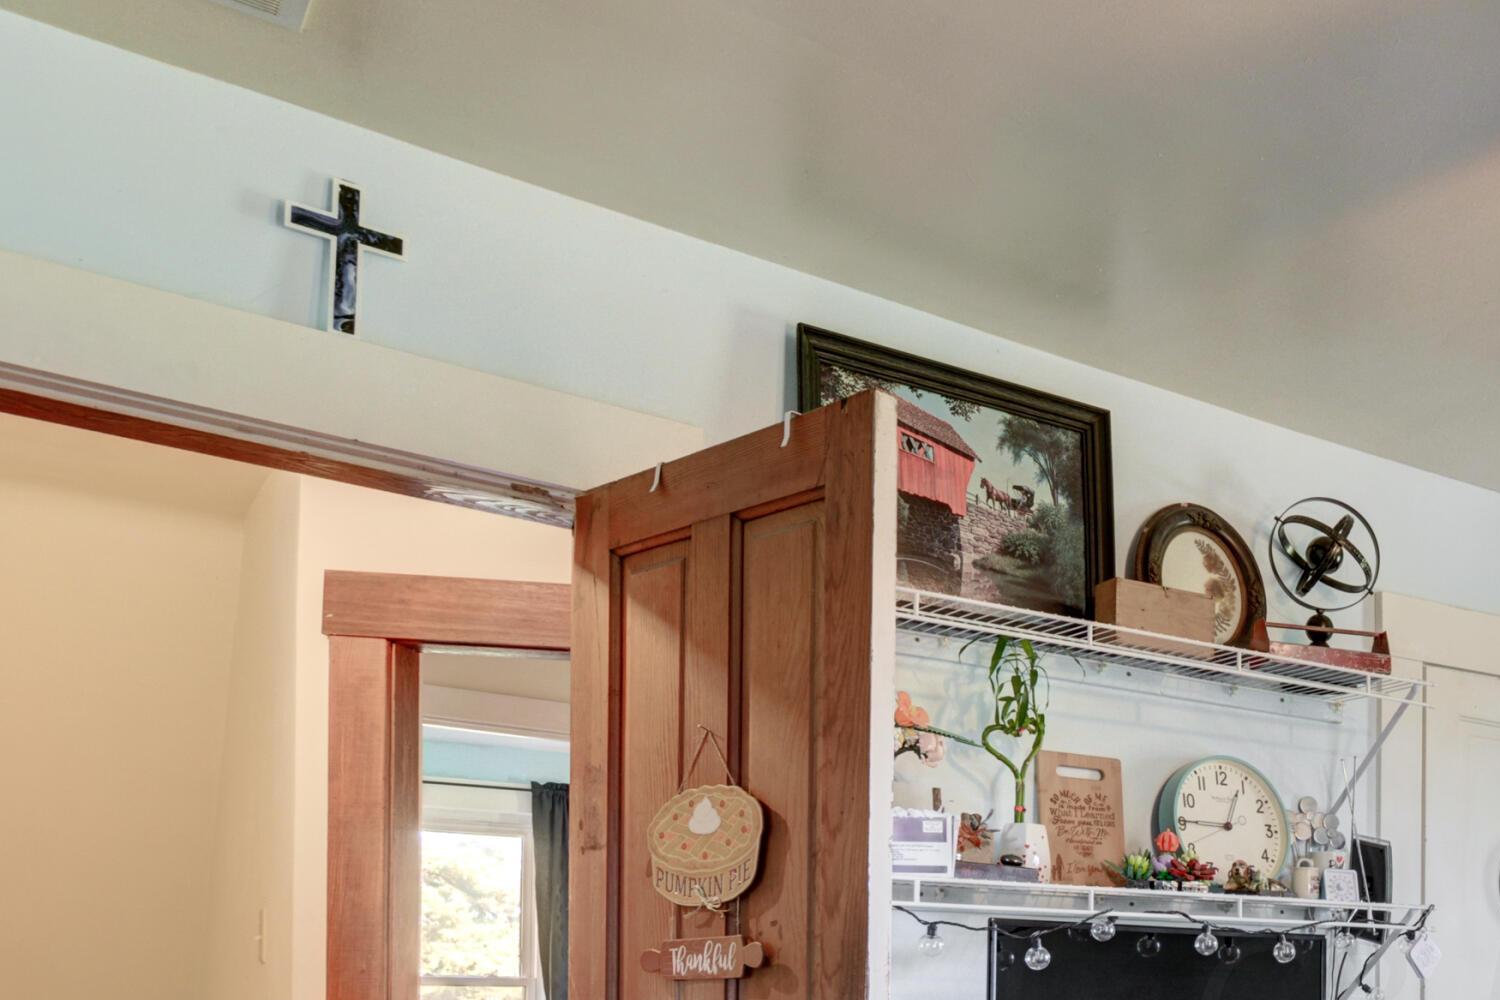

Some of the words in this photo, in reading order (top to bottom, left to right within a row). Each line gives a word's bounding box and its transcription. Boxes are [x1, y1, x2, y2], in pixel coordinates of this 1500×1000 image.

[1197, 775, 1206, 791] 11
[1215, 771, 1228, 786] 12
[1241, 780, 1245, 795] 1
[1182, 793, 1195, 808] 10
[1256, 799, 1265, 814] 2
[1178, 816, 1187, 831] 9
[1264, 824, 1274, 839] 3
[1261, 849, 1270, 862] 4
[656, 866, 723, 897] PUMPKIN
[728, 858, 751, 891] PIE
[669, 941, 737, 976] Thankful
